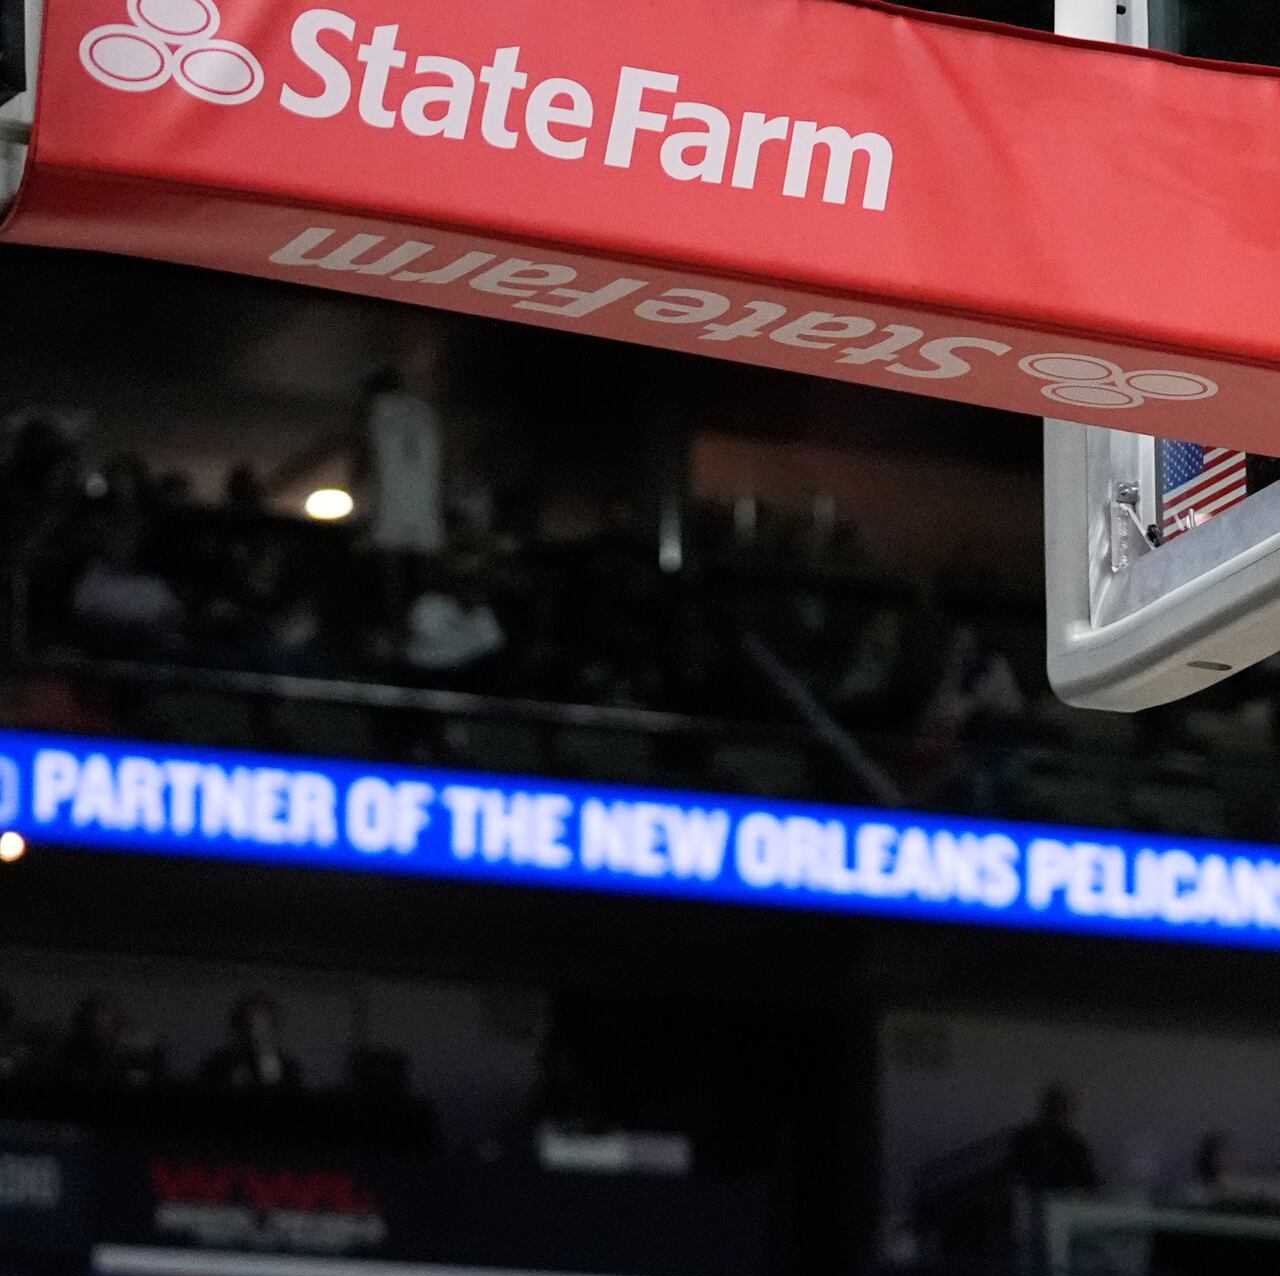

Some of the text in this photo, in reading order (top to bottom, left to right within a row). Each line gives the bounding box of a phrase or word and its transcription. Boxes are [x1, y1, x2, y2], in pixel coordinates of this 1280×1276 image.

[279, 9, 894, 212] State Farm
[269, 227, 1012, 379] State Farm
[33, 749, 336, 846] PARTNER
[345, 776, 434, 854] OF
[443, 786, 573, 868] THE
[580, 798, 729, 879] NEW
[735, 812, 1020, 908] ORLEANS
